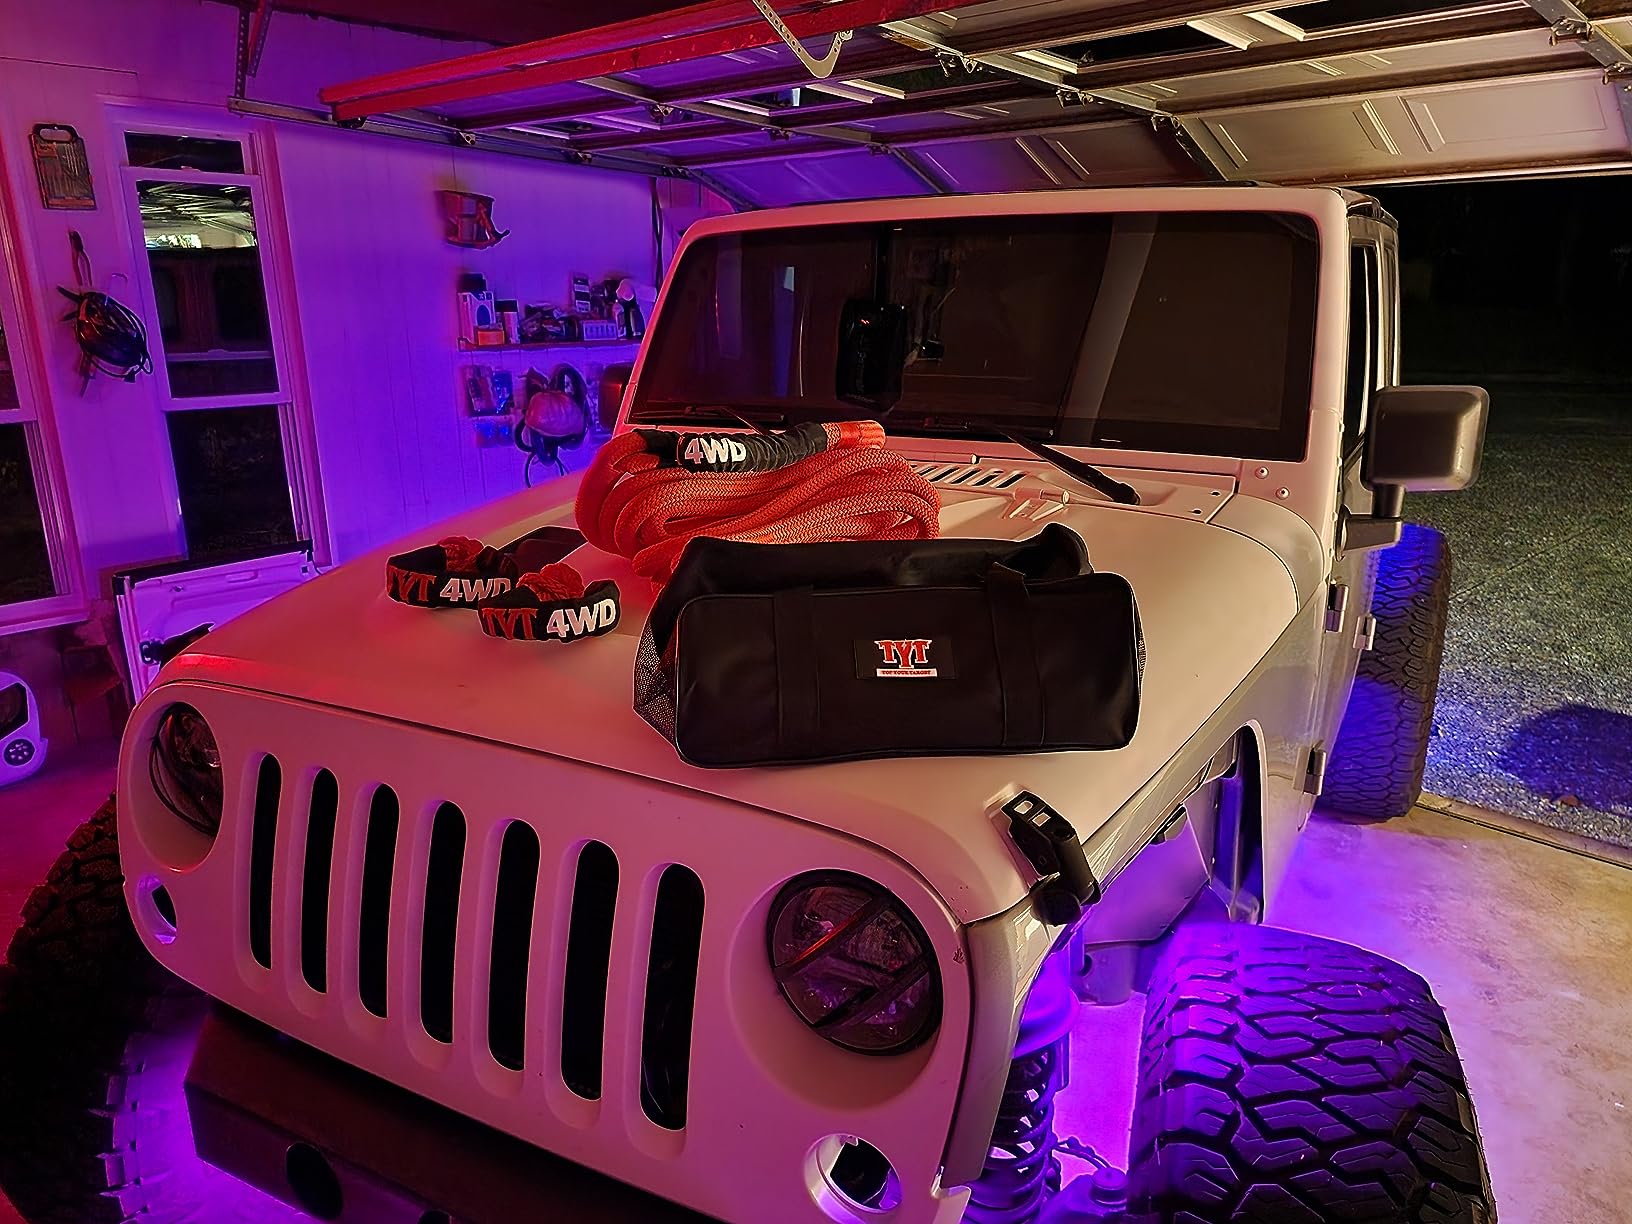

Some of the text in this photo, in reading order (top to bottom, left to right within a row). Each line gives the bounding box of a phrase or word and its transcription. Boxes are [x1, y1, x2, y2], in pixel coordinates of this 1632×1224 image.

[684, 437, 747, 464] 4WD
[440, 577, 511, 602] 4WD
[482, 598, 616, 640] TYT 4WD
[874, 639, 932, 668] TYT
